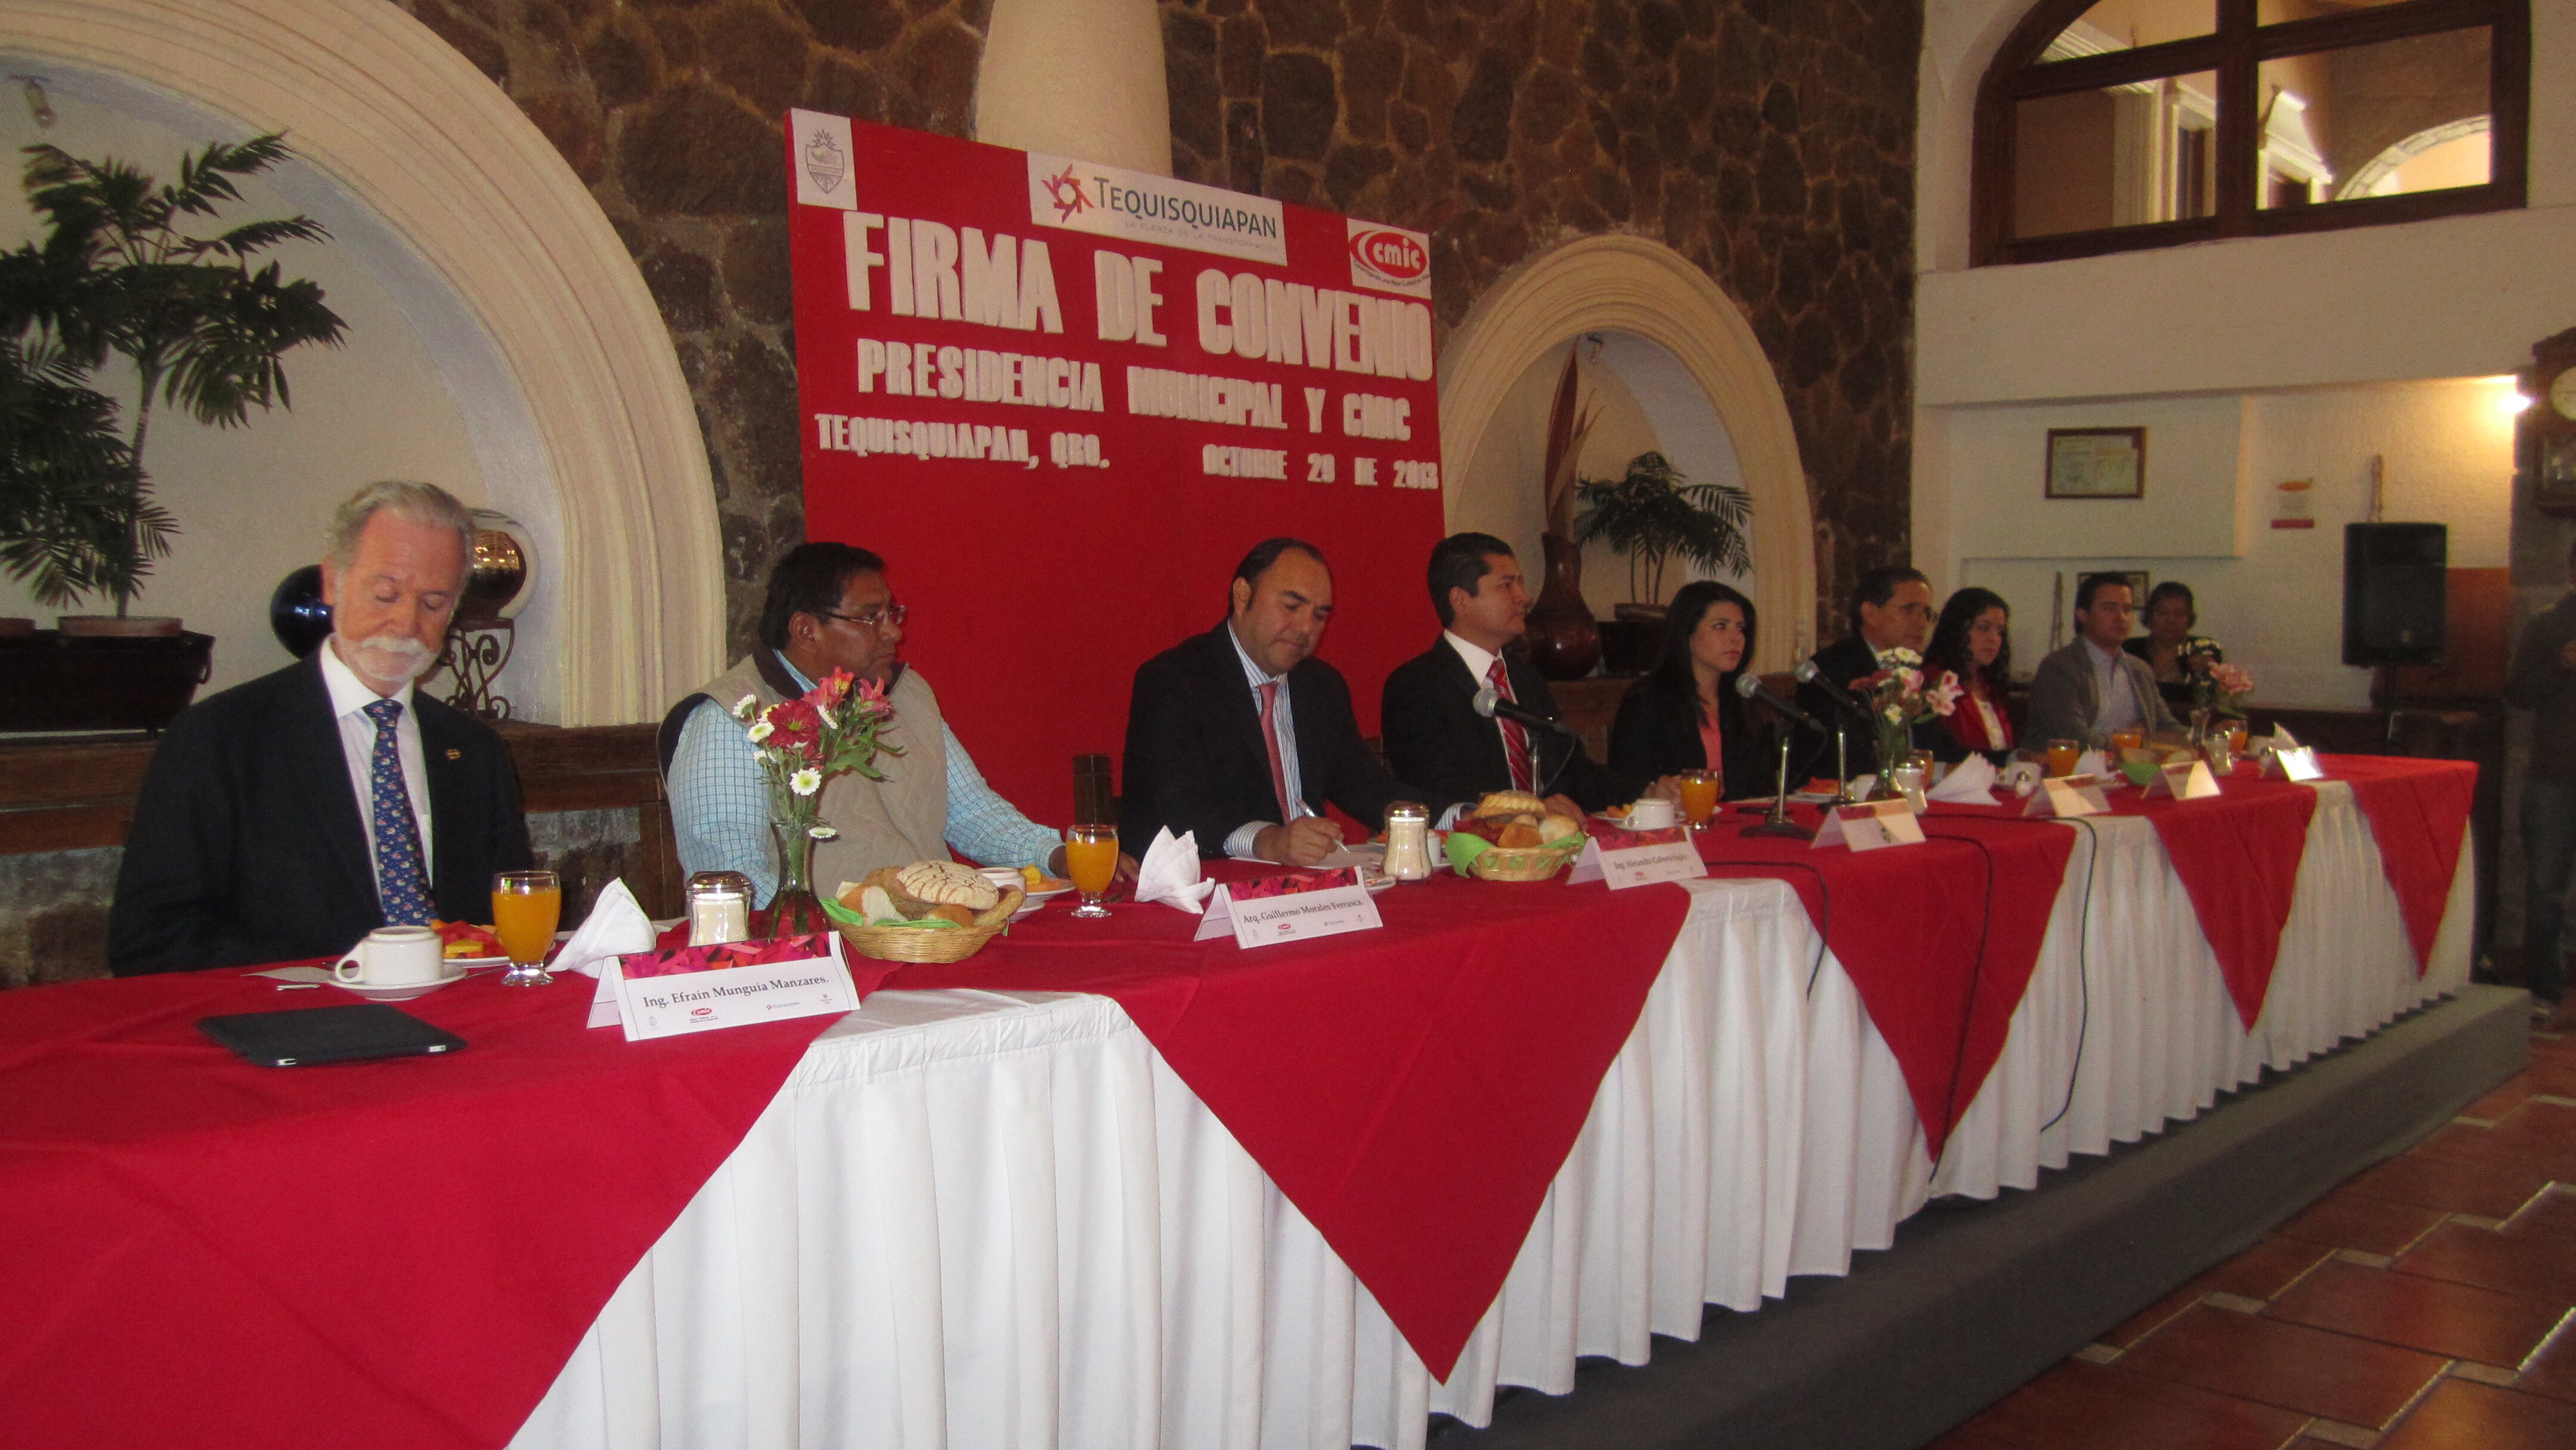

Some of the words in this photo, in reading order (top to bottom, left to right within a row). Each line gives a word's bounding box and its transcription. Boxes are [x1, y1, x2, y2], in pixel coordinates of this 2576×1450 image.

[1093, 176, 1277, 238] TEQUISQUIAPAN
[1373, 237, 1420, 269] cmic
[843, 210, 1064, 334] FIRMA
[1094, 249, 1167, 347] DE
[1196, 268, 1433, 382] CONVENIO
[857, 338, 1104, 412] PRESIDENCIA
[1127, 365, 1288, 429] MUNICIPAL
[1304, 386, 1326, 433] Y
[1343, 393, 1411, 441] CMIC
[815, 413, 1039, 469] TEQUISQUIAPAN,
[1050, 431, 1110, 469] QRO.
[1203, 444, 1288, 479] OCTUBRE
[1308, 453, 1335, 483] 29
[1354, 457, 1378, 485] DE
[1393, 460, 1438, 489] 2013
[1243, 915, 1261, 924] Arq.
[1261, 910, 1301, 920] Guillermo
[1300, 904, 1332, 914] Morales
[1331, 900, 1364, 910] Ferrusca.
[643, 997, 669, 1008] Ing.
[769, 976, 829, 989] Manzares.
